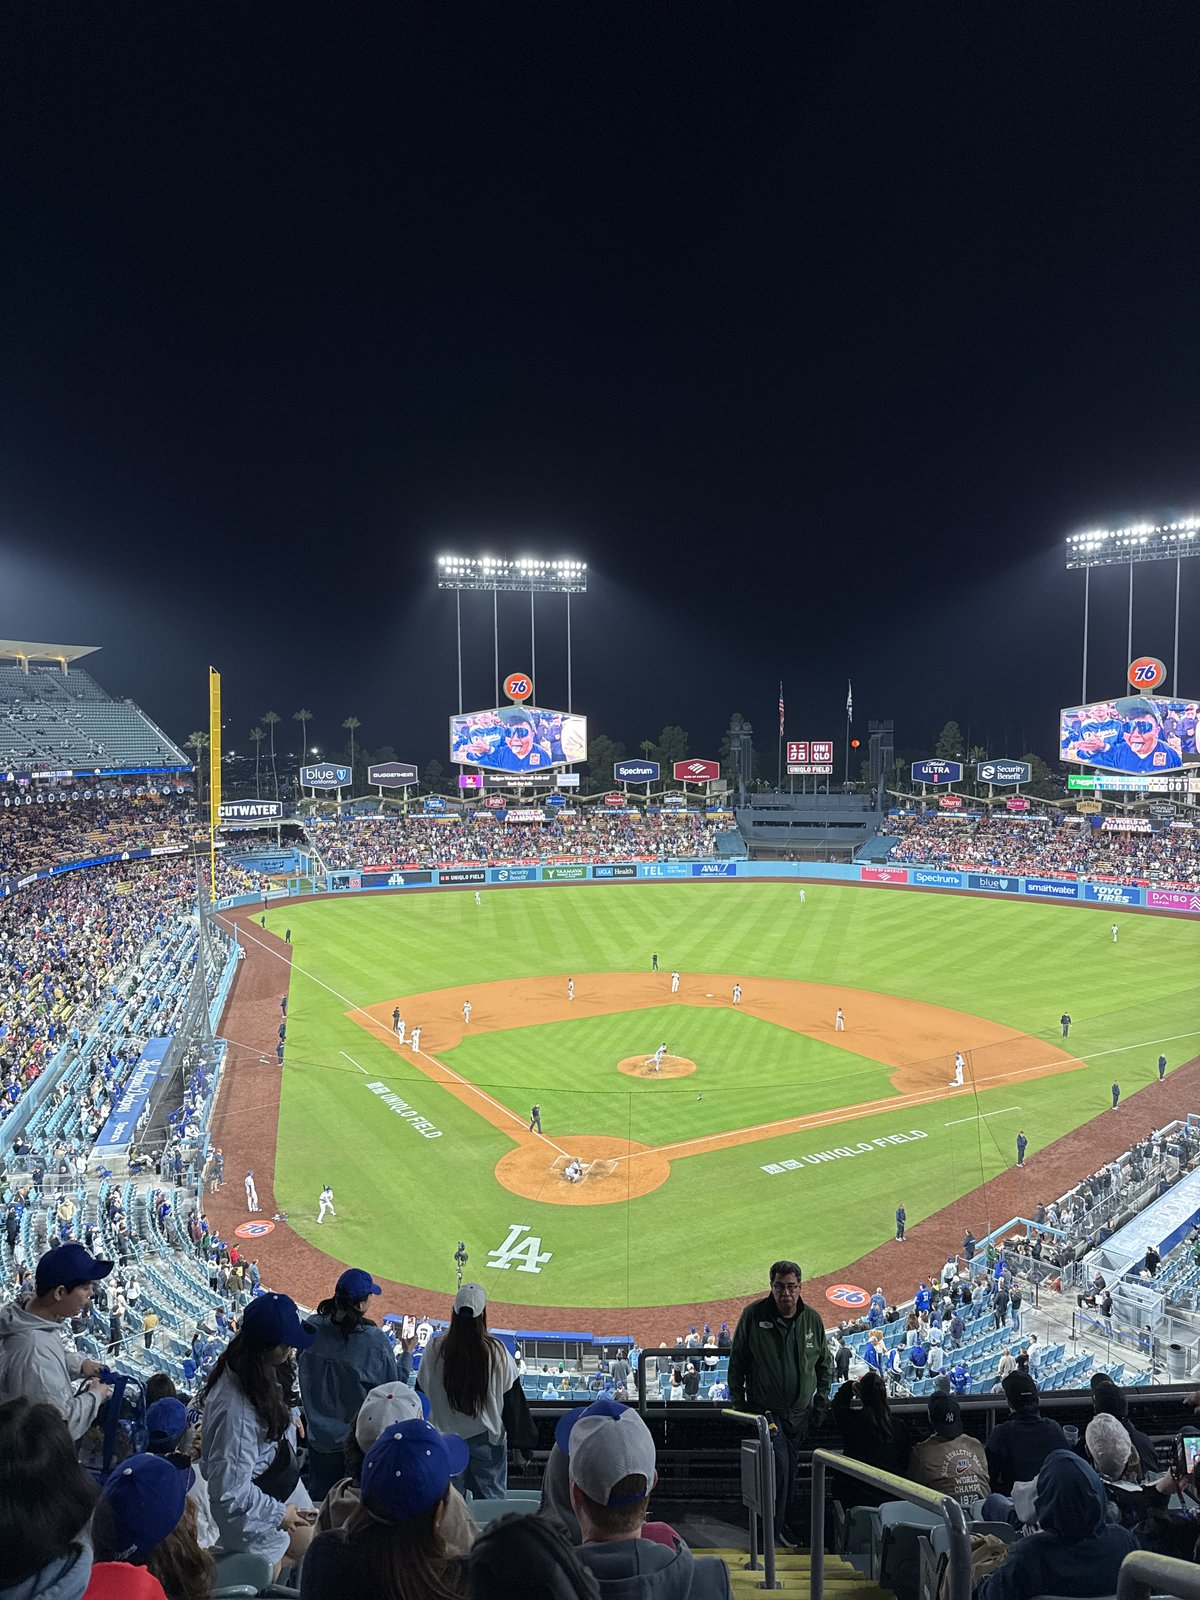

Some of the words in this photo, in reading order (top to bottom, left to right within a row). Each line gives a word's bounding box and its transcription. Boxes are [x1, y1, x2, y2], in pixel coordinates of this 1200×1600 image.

[1134, 664, 1156, 681] 76
[510, 680, 527, 694] 76
[306, 769, 334, 780] blue
[619, 767, 653, 776] Spectrum
[997, 765, 1025, 774] Security
[997, 772, 1022, 780] Benefit
[940, 798, 961, 806] Churu
[218, 804, 278, 817] CUTWATER
[643, 866, 663, 876] TEL
[701, 865, 719, 873] ANA
[916, 873, 956, 883] Spectrum
[980, 878, 999, 886] blue
[1027, 883, 1076, 895] smartwater
[1093, 887, 1123, 895] TOYO
[1097, 894, 1130, 903] TIRES
[1152, 893, 1187, 903] DAISO
[380, 1092, 418, 1117] UNIQLO
[406, 1116, 443, 1139] FIELD
[801, 1142, 874, 1164] UNIQLO
[871, 1130, 929, 1148] FIELD
[238, 1223, 272, 1236] 76
[485, 1224, 554, 1274] LA
[829, 1288, 868, 1304] 76
[946, 1449, 972, 1461] ATHLETIC
[955, 1475, 978, 1484] WORLD
[954, 1484, 981, 1494] CHAMPS
